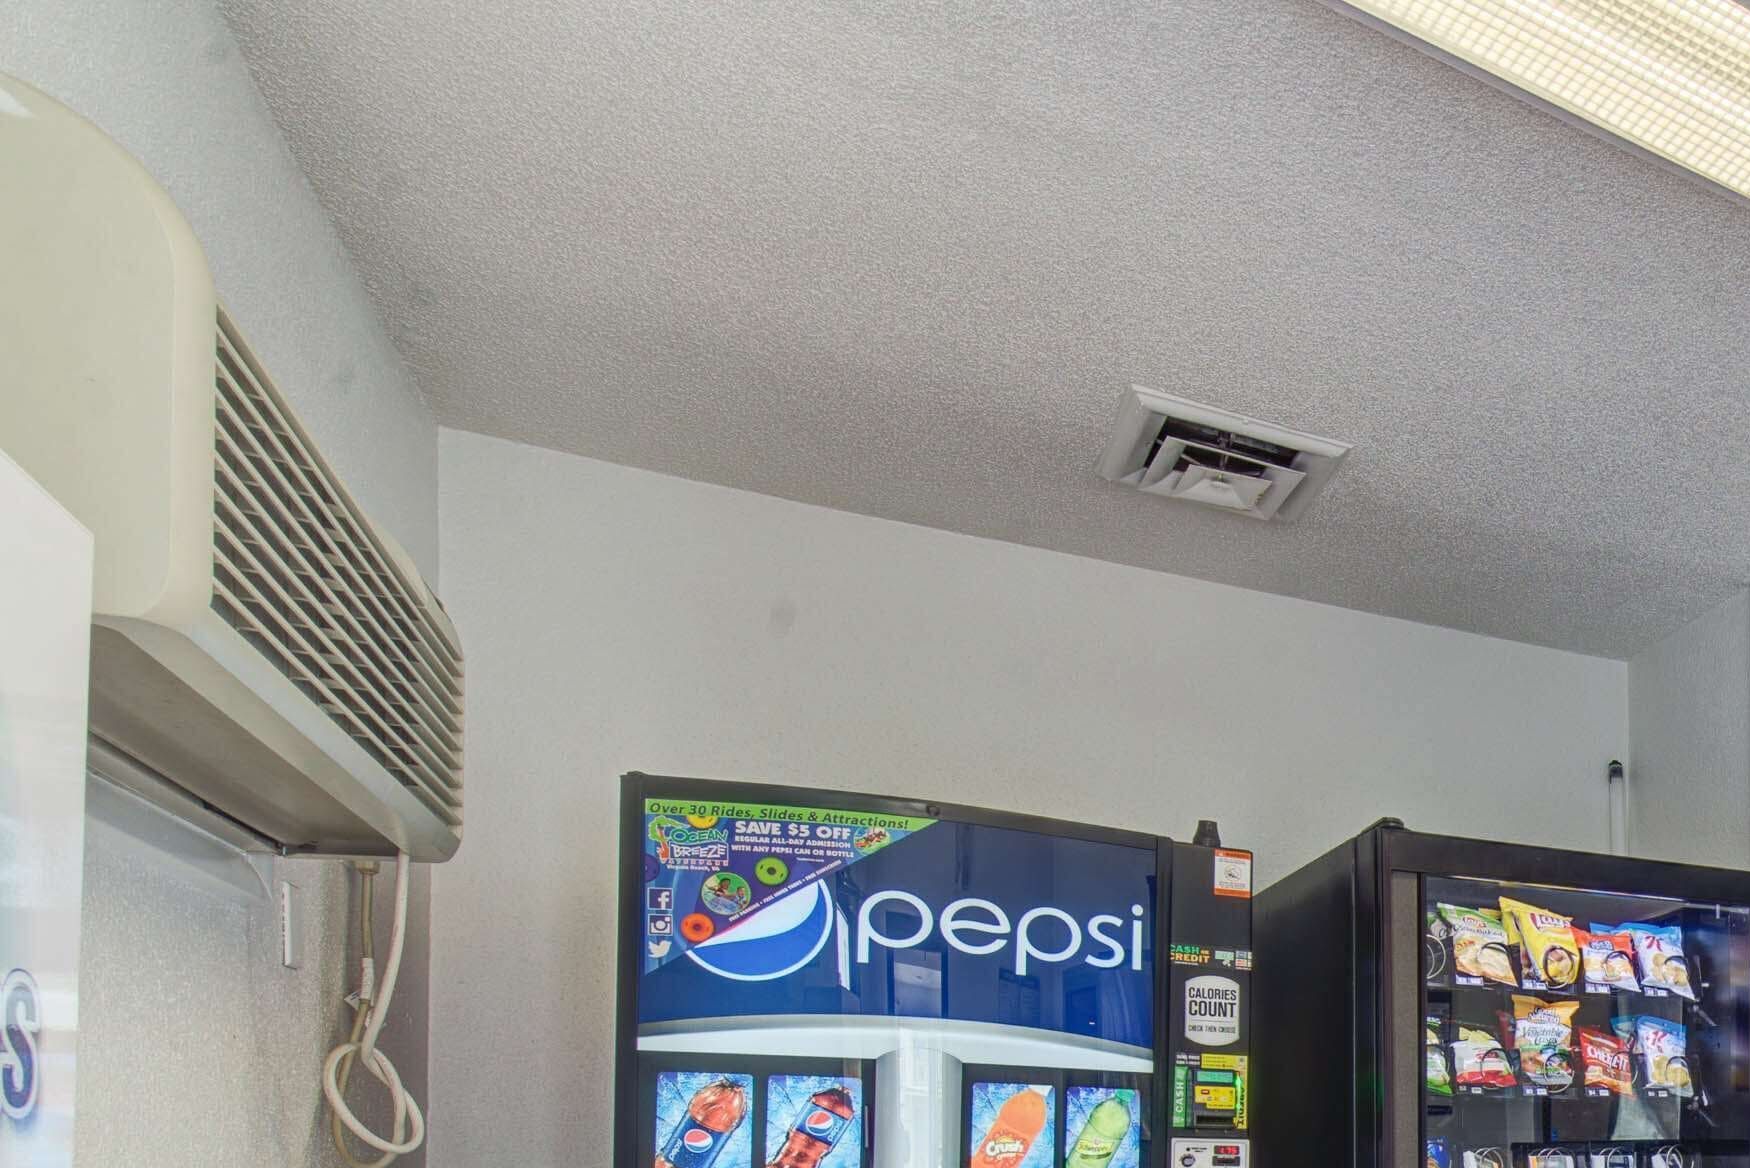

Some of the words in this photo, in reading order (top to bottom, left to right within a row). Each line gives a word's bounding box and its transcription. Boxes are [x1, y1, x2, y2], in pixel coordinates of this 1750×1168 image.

[650, 803, 684, 815] Over
[688, 804, 707, 815] 30
[711, 805, 755, 819] Rides,
[759, 808, 805, 821] Slides
[808, 811, 818, 822] &
[822, 812, 909, 829] Attractions!
[735, 820, 781, 836] SAVE
[788, 822, 810, 838] $5
[816, 825, 851, 840] OFF
[671, 843, 727, 859] BREEZE
[731, 844, 751, 852] WITH
[753, 845, 770, 853] ANY
[771, 846, 793, 854] PEPSI
[826, 850, 855, 858] BOTTLE
[734, 835, 770, 844] REGULAR
[771, 837, 805, 846] ALL-DAY
[806, 840, 851, 849] ADMISSION
[857, 890, 1143, 977] pepsi
[1188, 986, 1237, 1001] CALORIES
[1188, 1000, 1237, 1018] COUNT
[1175, 1082, 1185, 1113] CASH
[985, 1139, 1025, 1157] Crush
